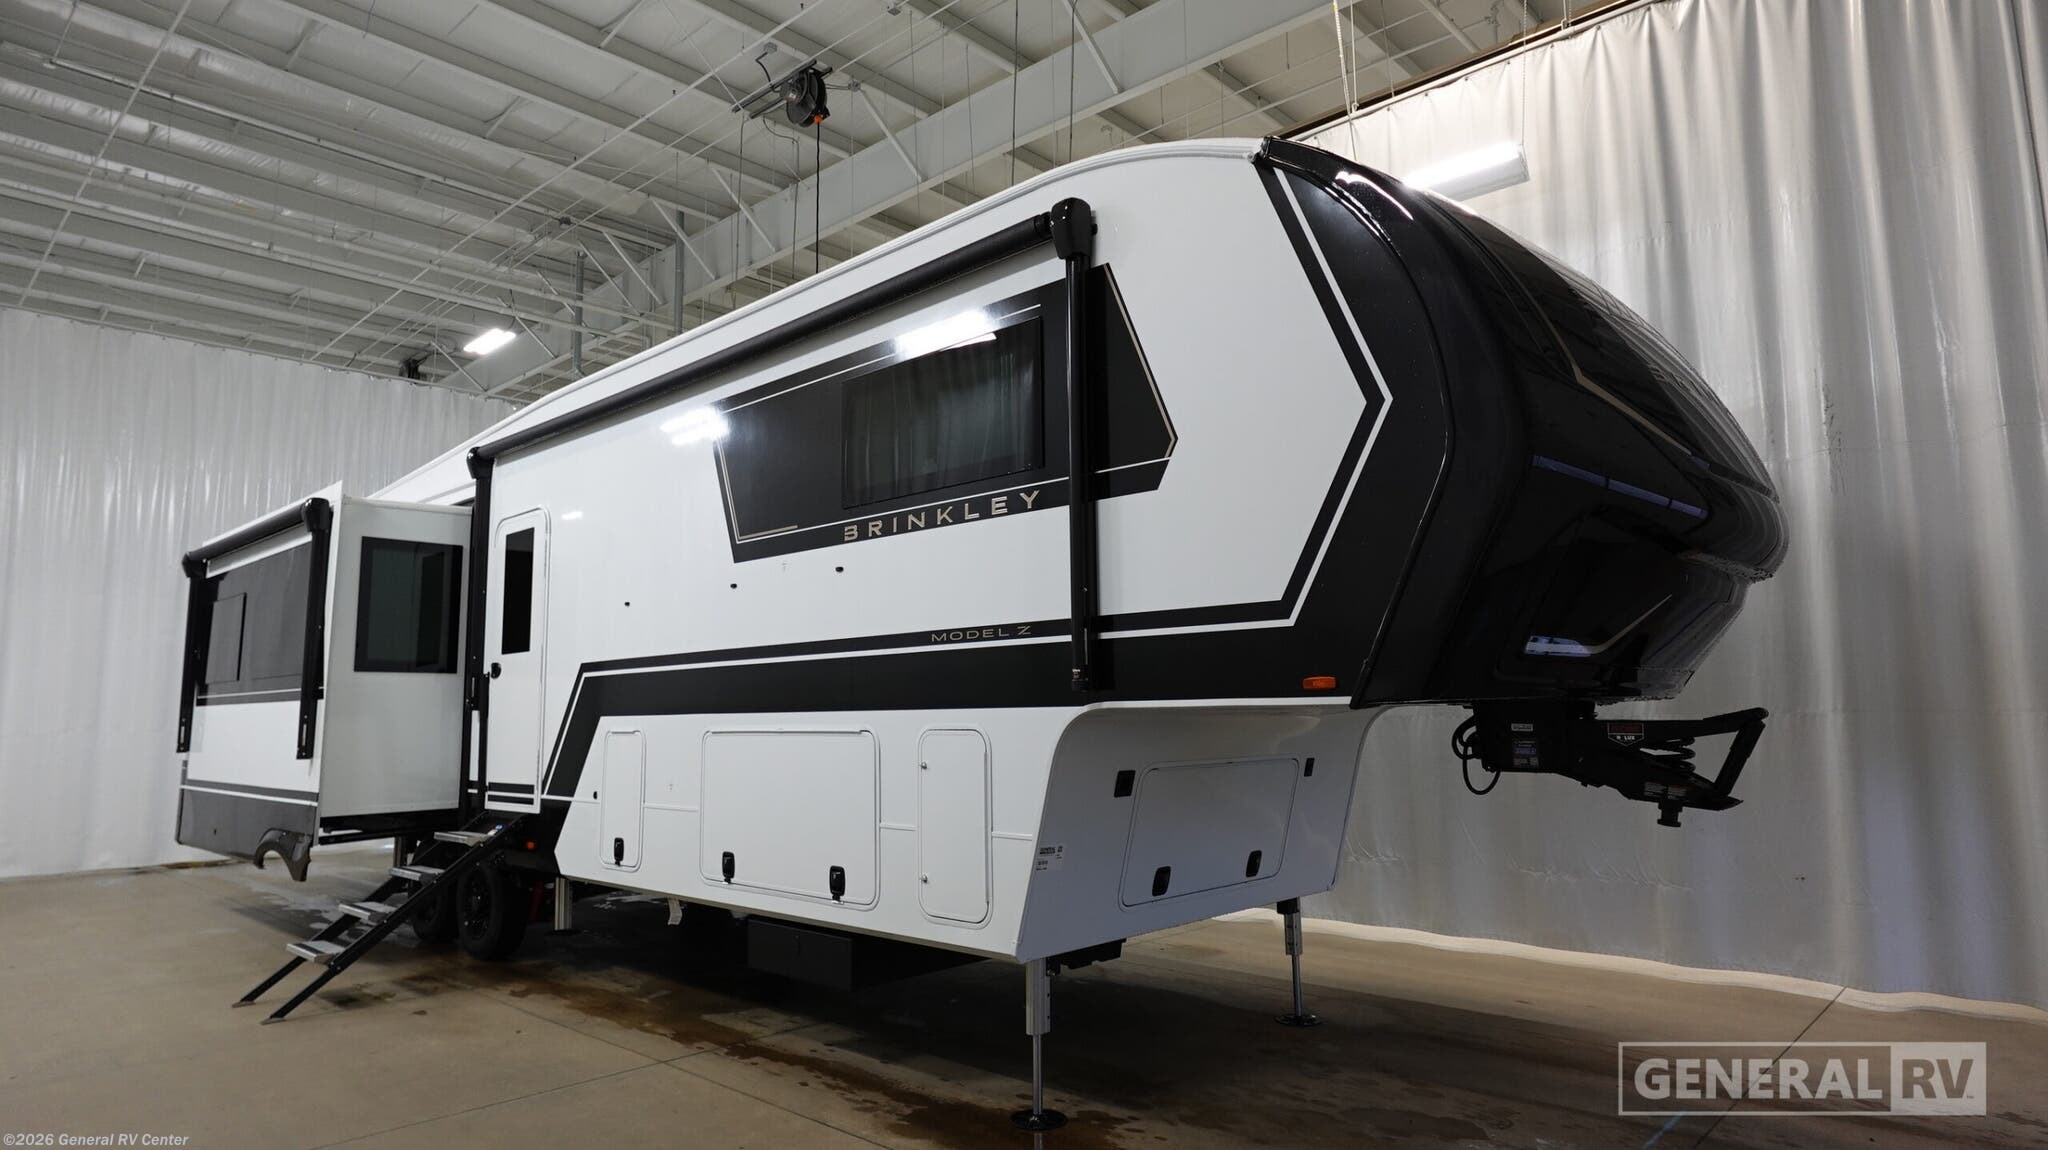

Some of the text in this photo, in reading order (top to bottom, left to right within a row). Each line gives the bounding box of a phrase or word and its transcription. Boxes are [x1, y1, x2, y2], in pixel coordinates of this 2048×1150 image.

[843, 489, 1040, 542] BRINKLEY
[931, 625, 1031, 642] MODEL Z
